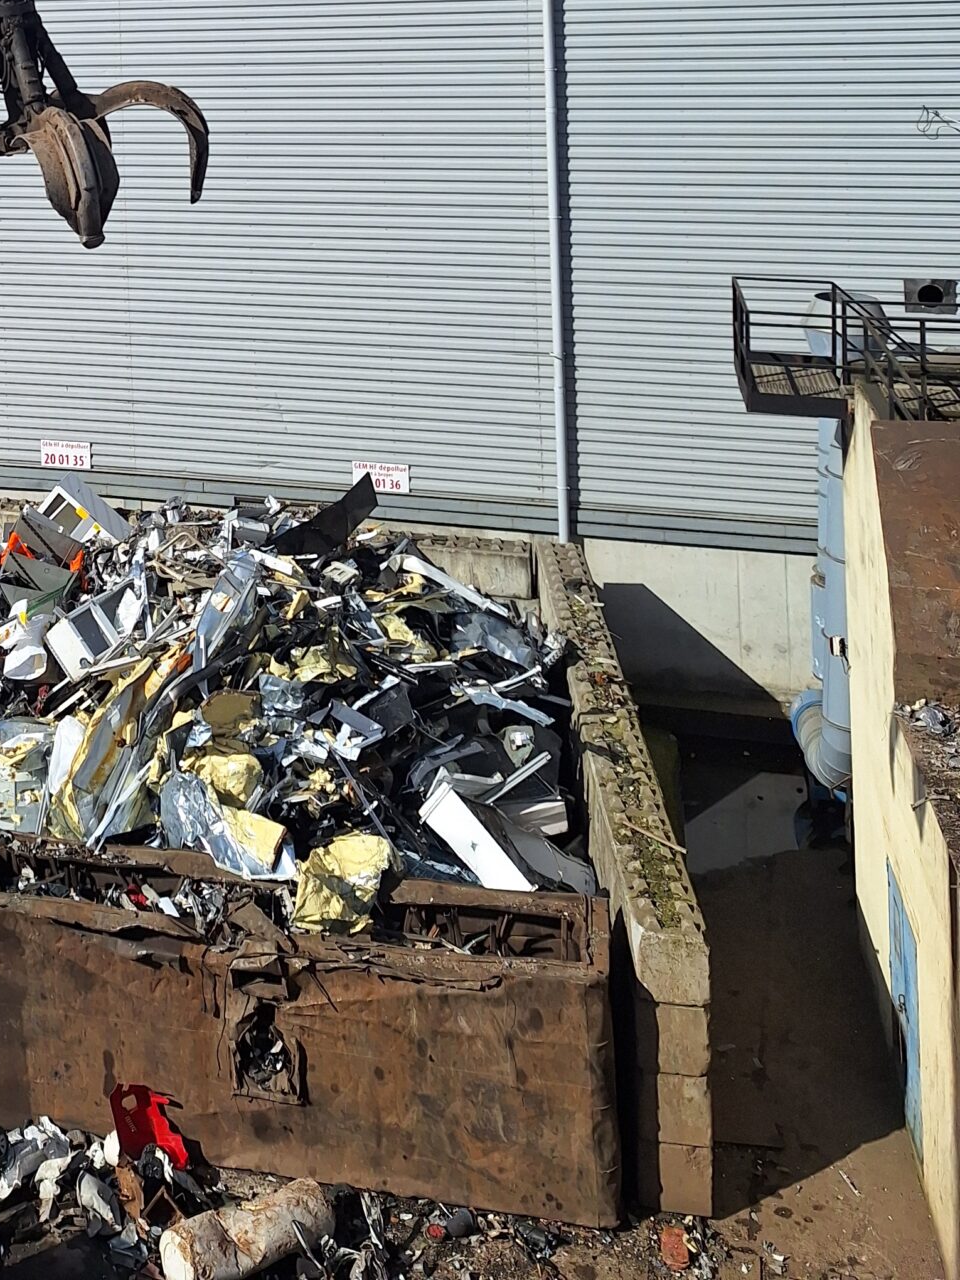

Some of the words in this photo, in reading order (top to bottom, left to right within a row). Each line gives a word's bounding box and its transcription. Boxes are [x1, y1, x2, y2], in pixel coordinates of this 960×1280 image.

[44, 453, 56, 464] 20
[58, 454, 69, 465] 01
[353, 462, 368, 470] GEM
[375, 478, 386, 489] 01
[389, 479, 401, 490] 36
